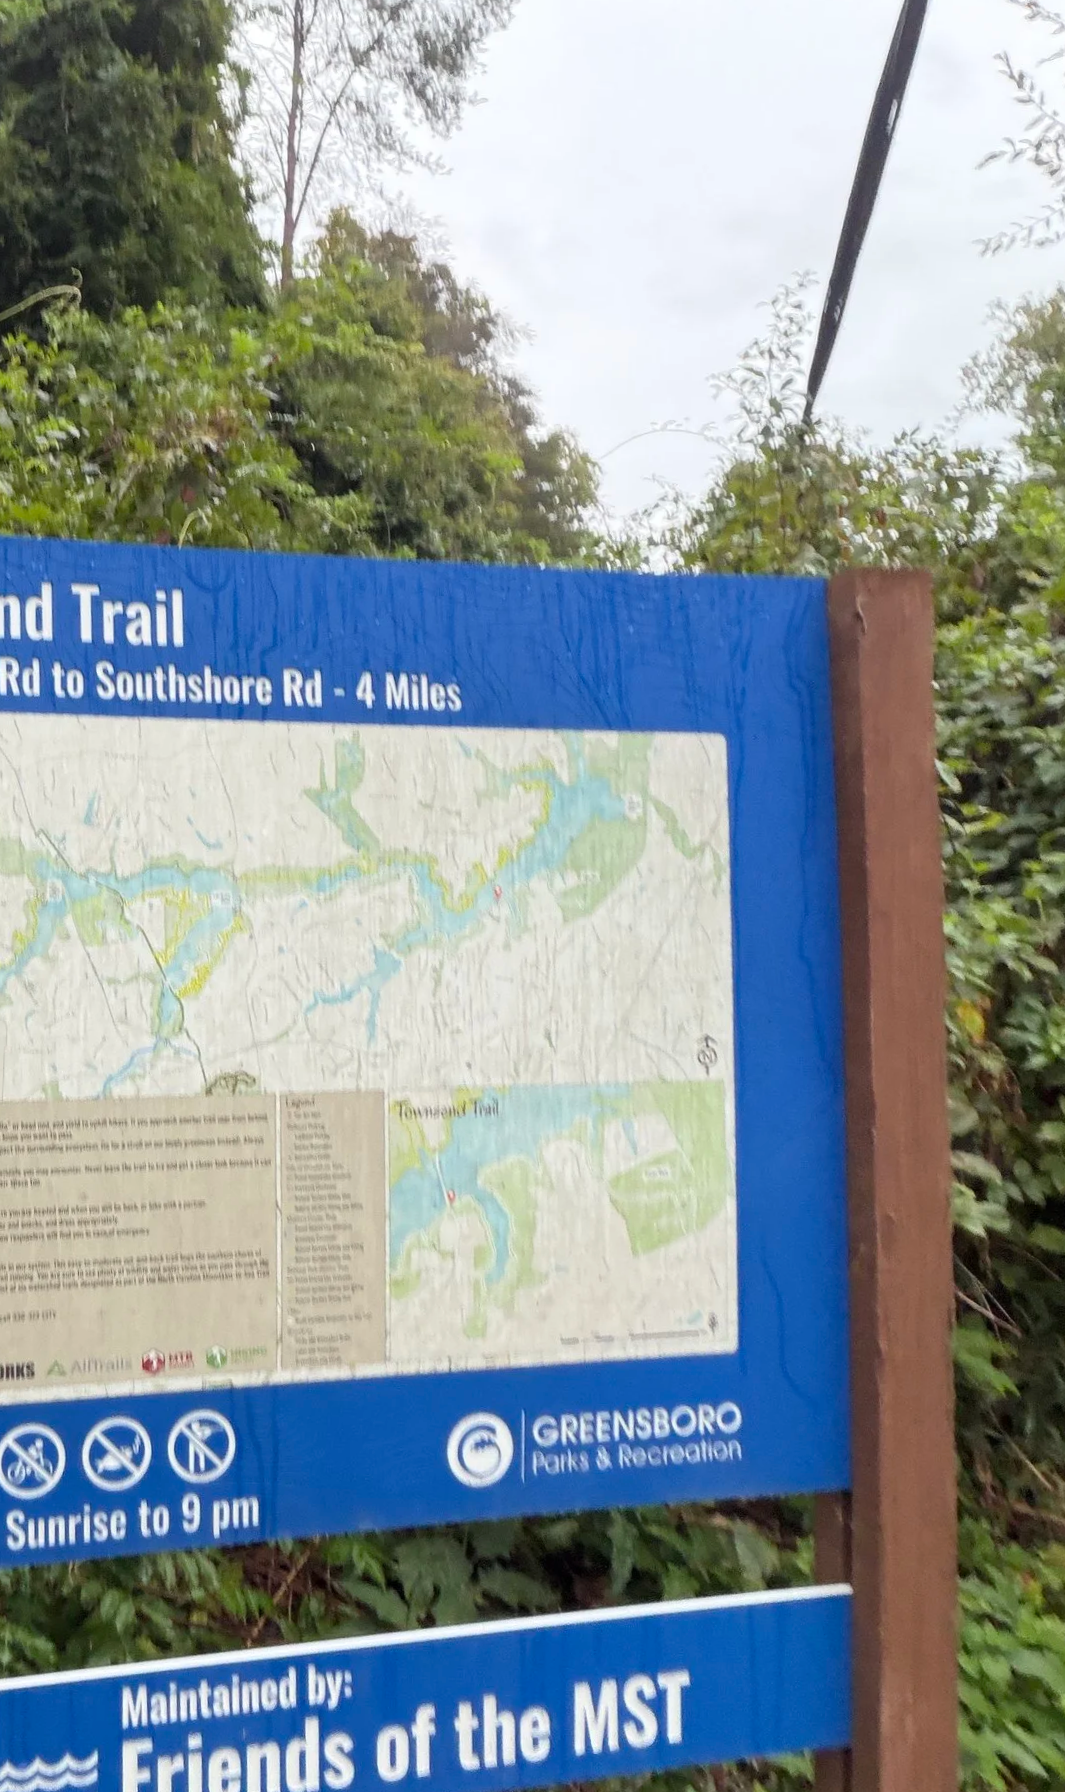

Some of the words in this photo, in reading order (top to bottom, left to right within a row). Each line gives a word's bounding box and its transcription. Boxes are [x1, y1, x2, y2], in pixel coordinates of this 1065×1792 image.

[71, 583, 184, 648] Trail
[52, 660, 85, 700] to
[96, 662, 273, 707] Southshore
[284, 669, 323, 708] Rd
[356, 673, 374, 709] 4
[386, 672, 463, 712] Miles
[532, 1401, 743, 1447] GREENSBORO
[532, 1448, 589, 1476] Parks
[596, 1445, 613, 1470] &
[618, 1438, 742, 1470] Recreation
[6, 1502, 127, 1552] Sunrise
[139, 1499, 170, 1539] to
[182, 1492, 201, 1534] 9
[212, 1494, 260, 1539] pm
[121, 1667, 297, 1730] Maintained
[308, 1663, 353, 1711] by:
[121, 1716, 355, 1792] Friends
[376, 1703, 437, 1784] of
[455, 1694, 551, 1770] the
[572, 1670, 690, 1757] MST
